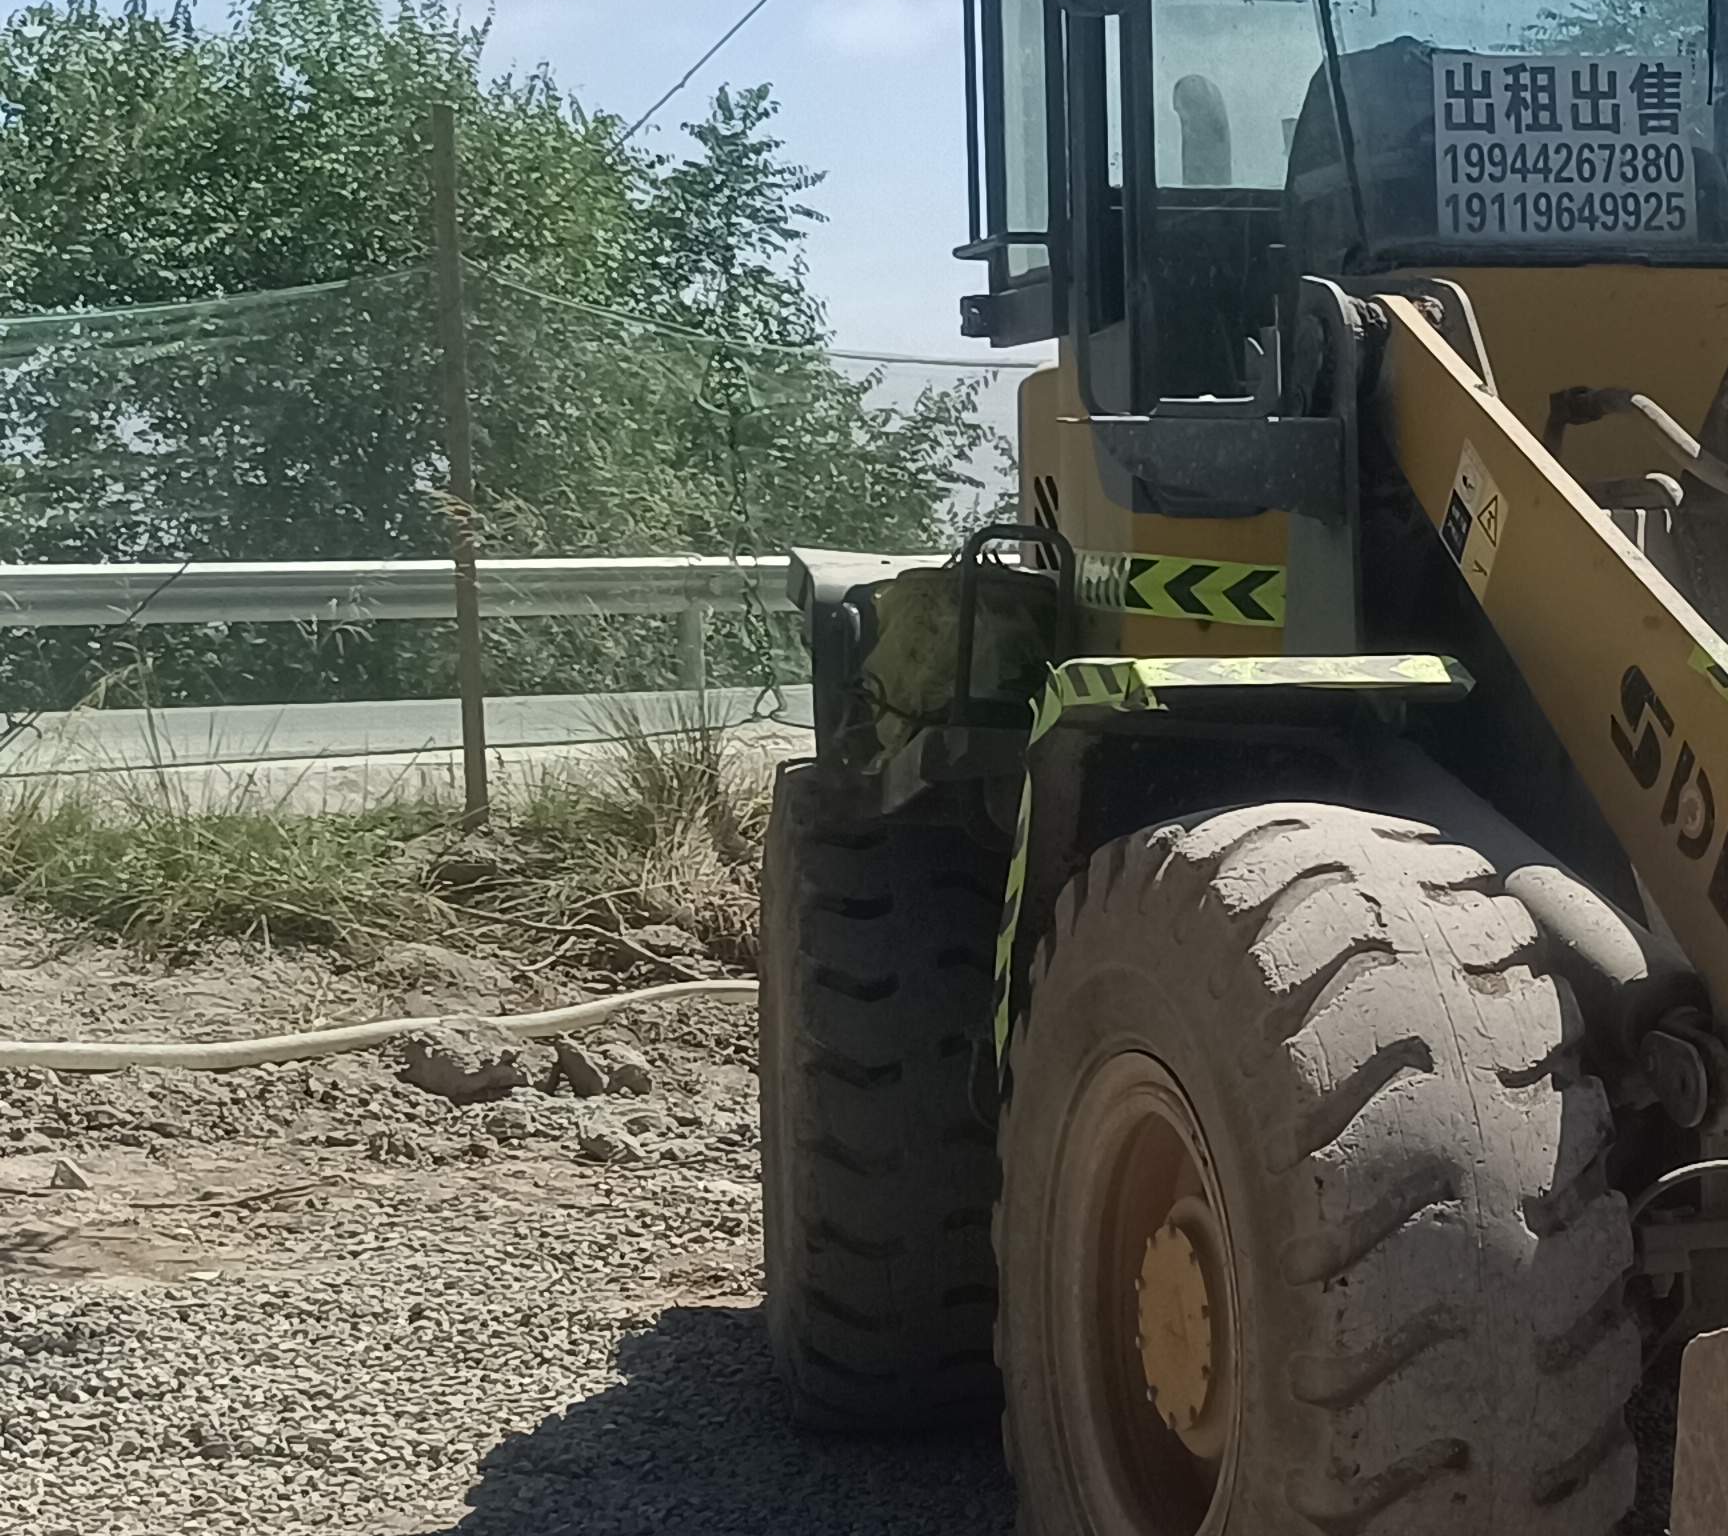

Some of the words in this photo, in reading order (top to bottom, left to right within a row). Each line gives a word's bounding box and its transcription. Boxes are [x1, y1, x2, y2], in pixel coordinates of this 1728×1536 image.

[1443, 62, 1683, 136] 出租出售
[1443, 142, 1685, 184] 19944267380
[1444, 191, 1687, 234] 19119649925
